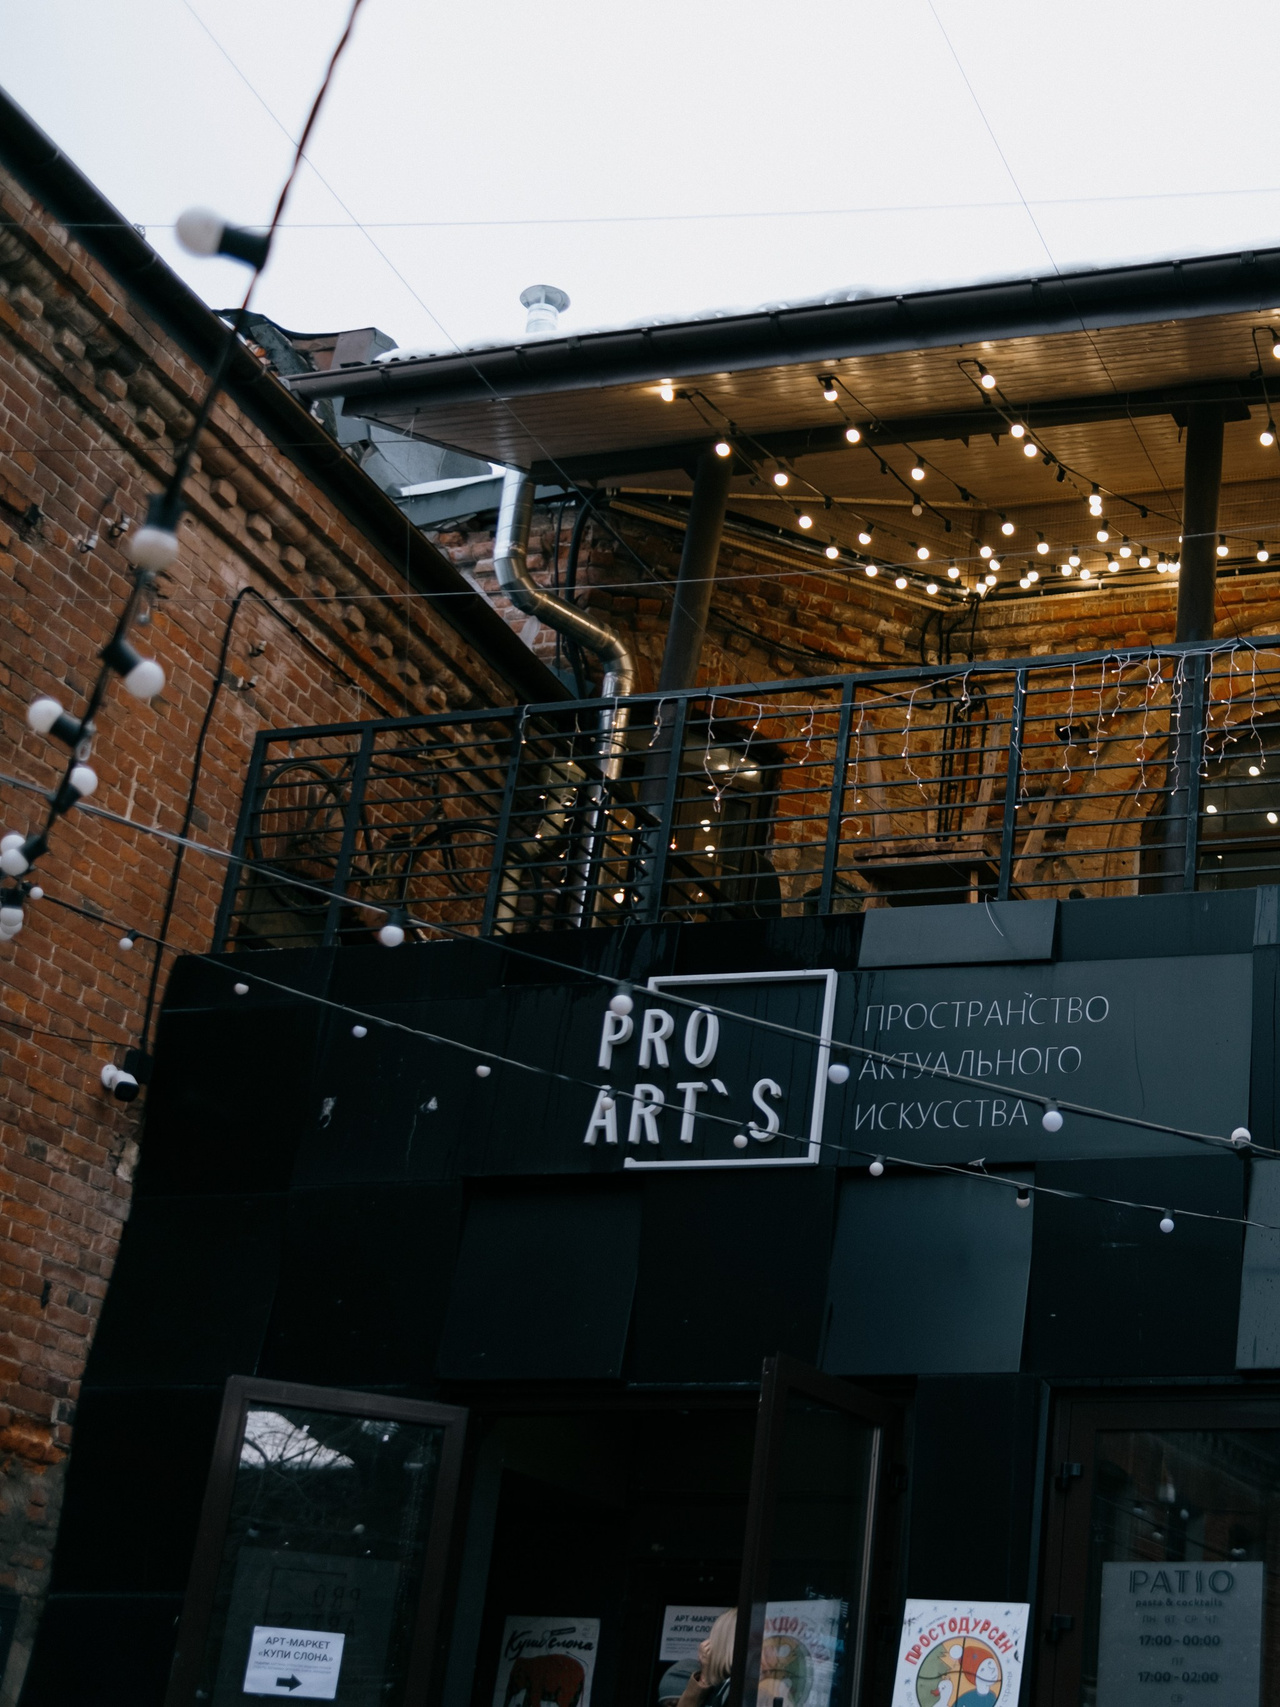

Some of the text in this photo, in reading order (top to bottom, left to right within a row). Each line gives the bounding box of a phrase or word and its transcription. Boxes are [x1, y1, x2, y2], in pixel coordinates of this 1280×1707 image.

[863, 994, 1111, 1033] ПРОСТРАНСТВО
[598, 1006, 720, 1070] PRO
[857, 1045, 1083, 1082] АКТУАЛЬНОГО
[854, 1098, 1030, 1132] ИСКУССТВА
[1129, 1569, 1235, 1594] PATIO
[1136, 1600, 1163, 1608] pasta
[1176, 1598, 1223, 1606] cocktails
[674, 1614, 720, 1623] АРТ-МАРКЕ
[264, 1636, 331, 1650] АРТ-МАРКЕТ
[904, 1616, 1013, 1666] ПРОСТОДУРСЕН
[1139, 1635, 1172, 1646] 17:00
[1182, 1635, 1221, 1646] 00:00
[258, 1649, 334, 1662] «КУПИ СЛОНА»
[1138, 1672, 1171, 1683] 17:00
[1182, 1672, 1219, 1683] 02:00
